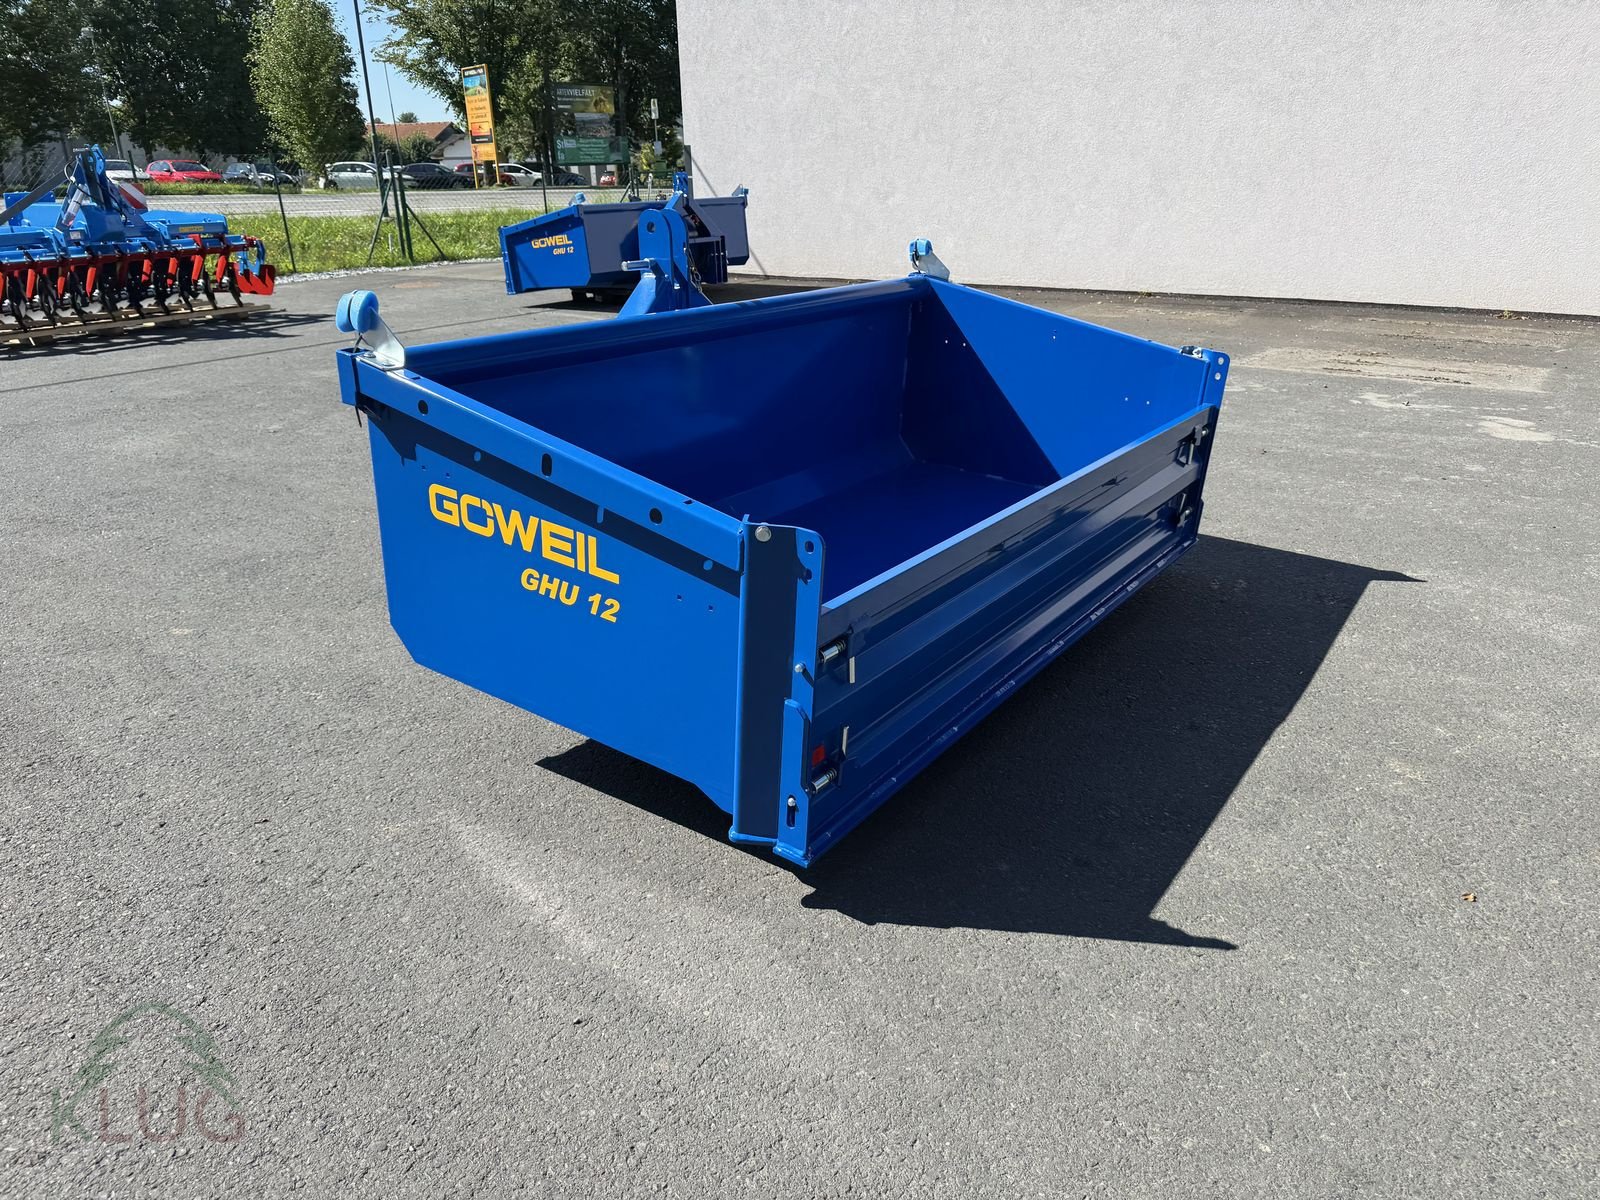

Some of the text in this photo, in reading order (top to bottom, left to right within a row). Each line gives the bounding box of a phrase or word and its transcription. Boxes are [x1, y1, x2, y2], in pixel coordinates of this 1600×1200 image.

[566, 246, 574, 254] 12
[520, 568, 621, 623] GHU 12
